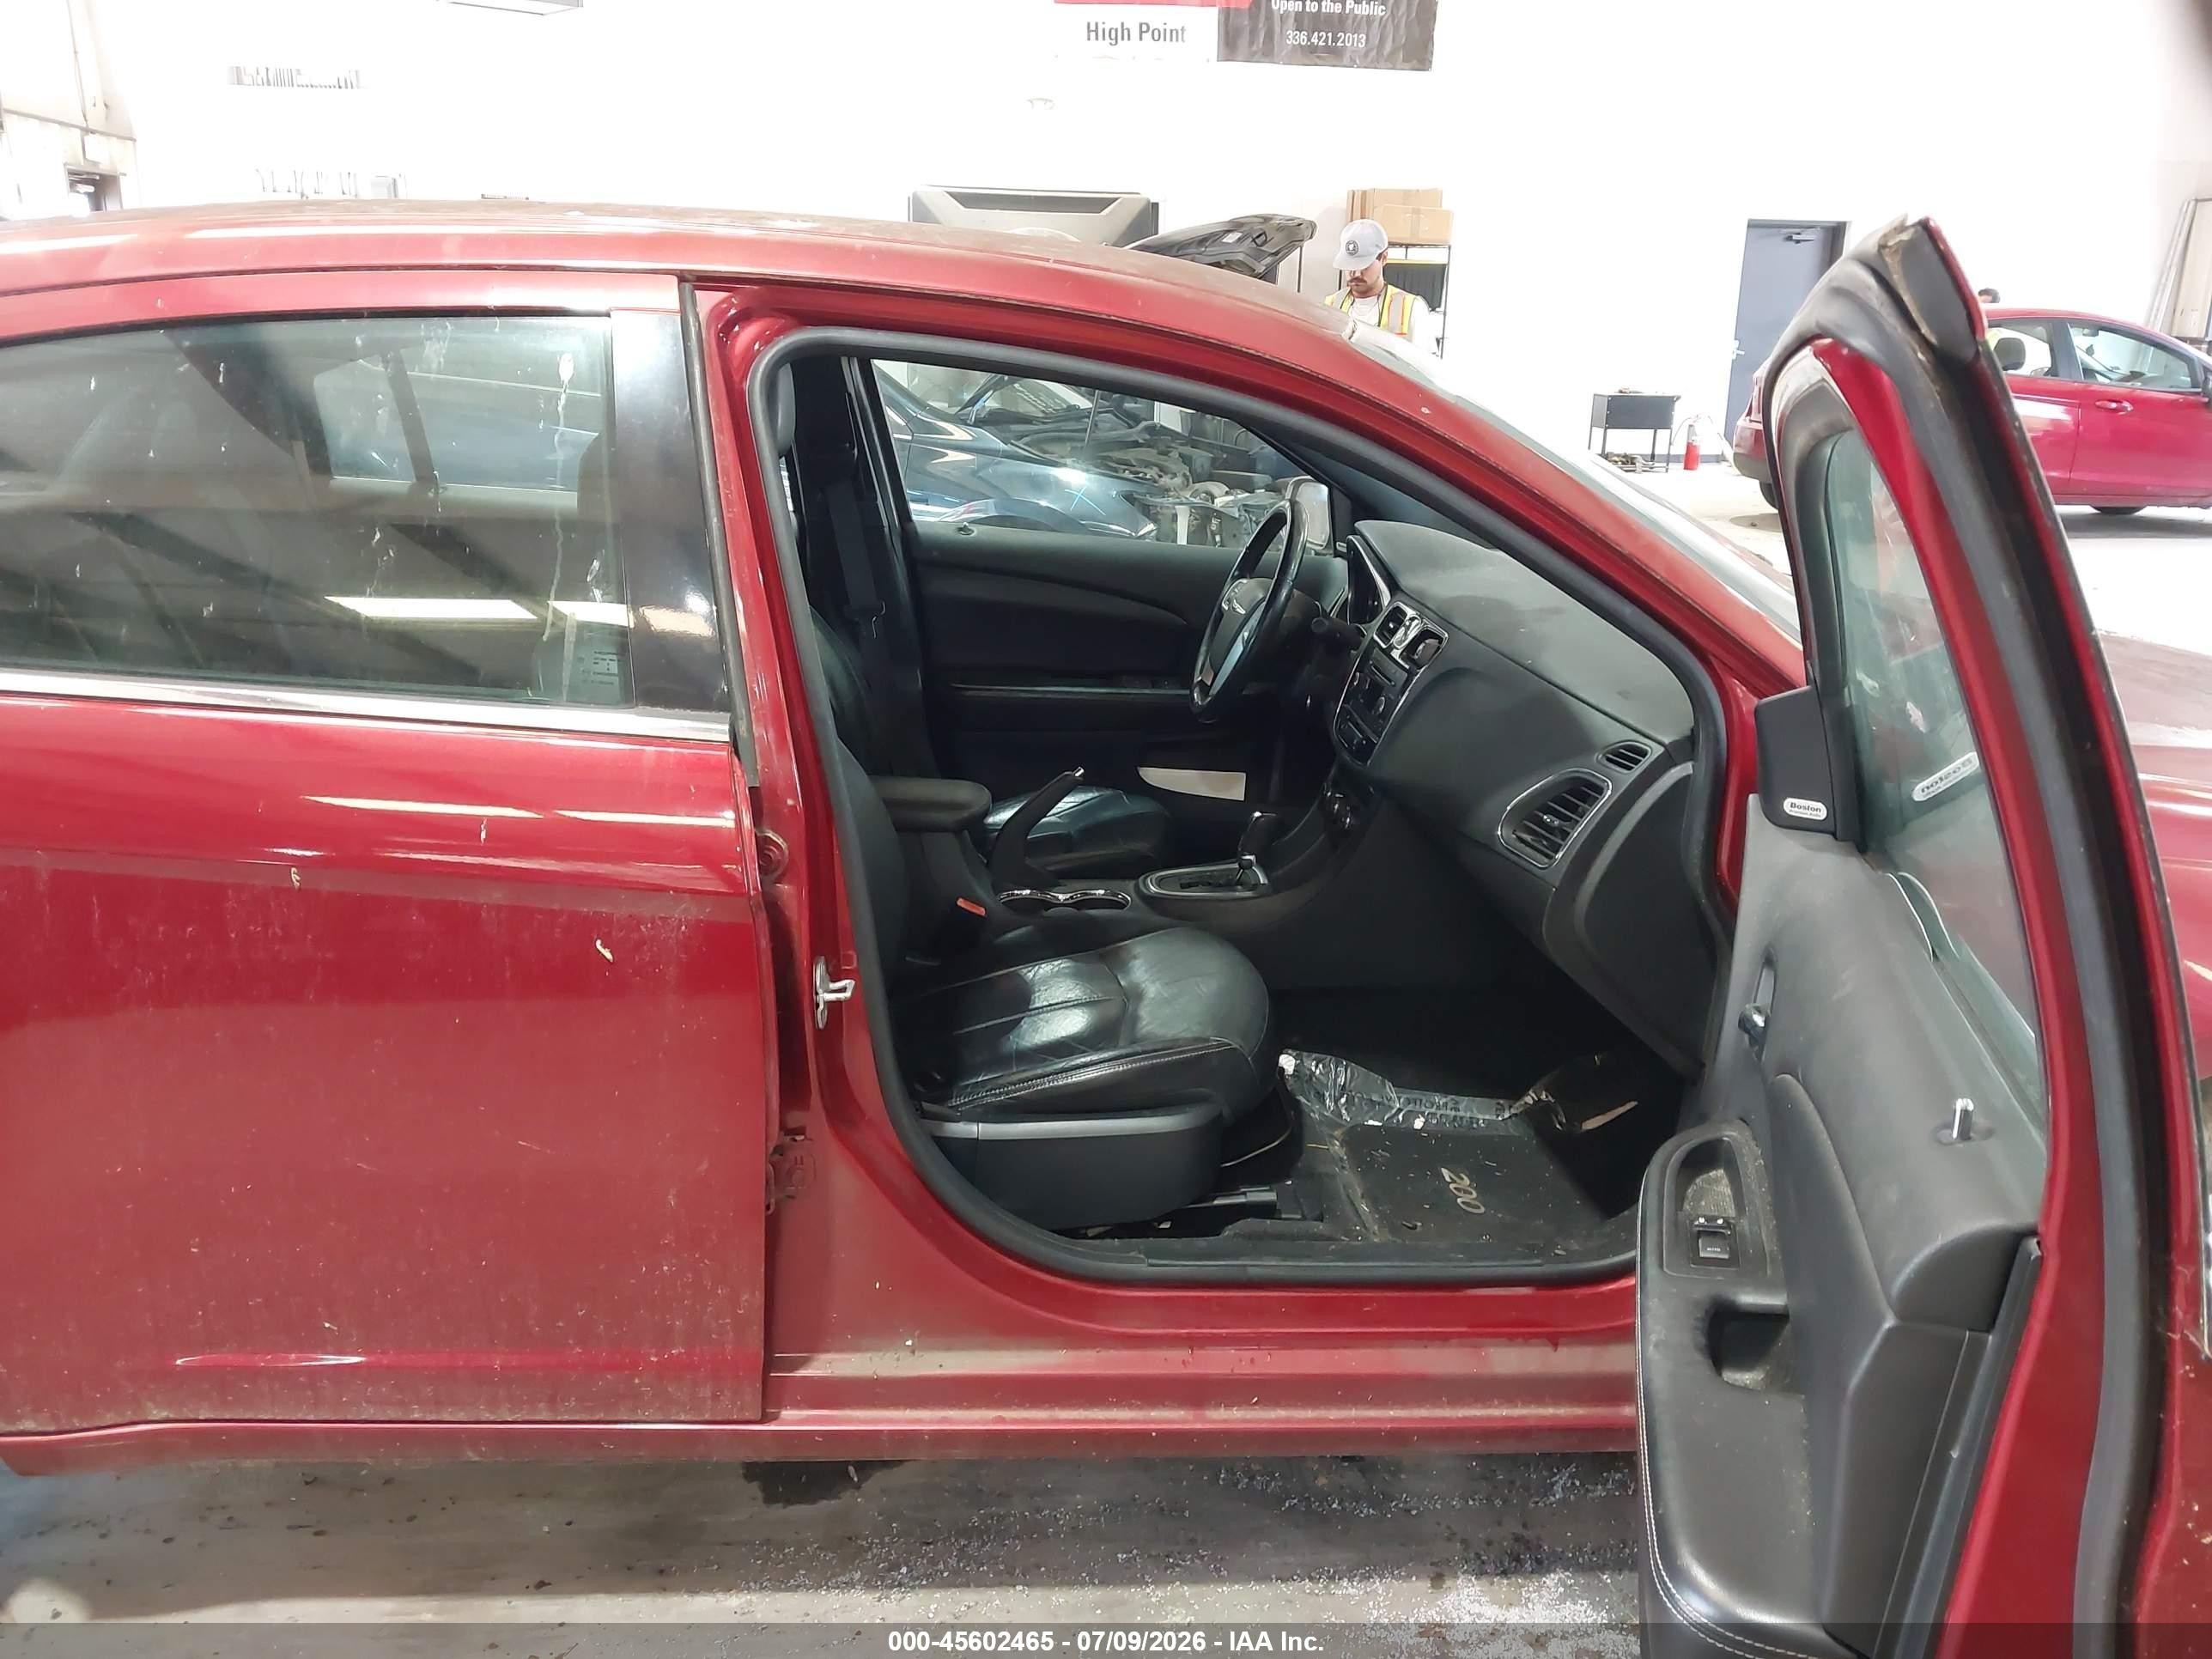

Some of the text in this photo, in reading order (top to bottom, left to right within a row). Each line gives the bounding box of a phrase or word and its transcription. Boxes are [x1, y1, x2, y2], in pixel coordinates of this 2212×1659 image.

[1271, 0, 1387, 15] Open to the Public
[1086, 21, 1187, 46] High Point
[1285, 30, 1367, 47] 336.421.2013
[1790, 801, 1821, 813] Boston
[1441, 1168, 1485, 1213] 200
